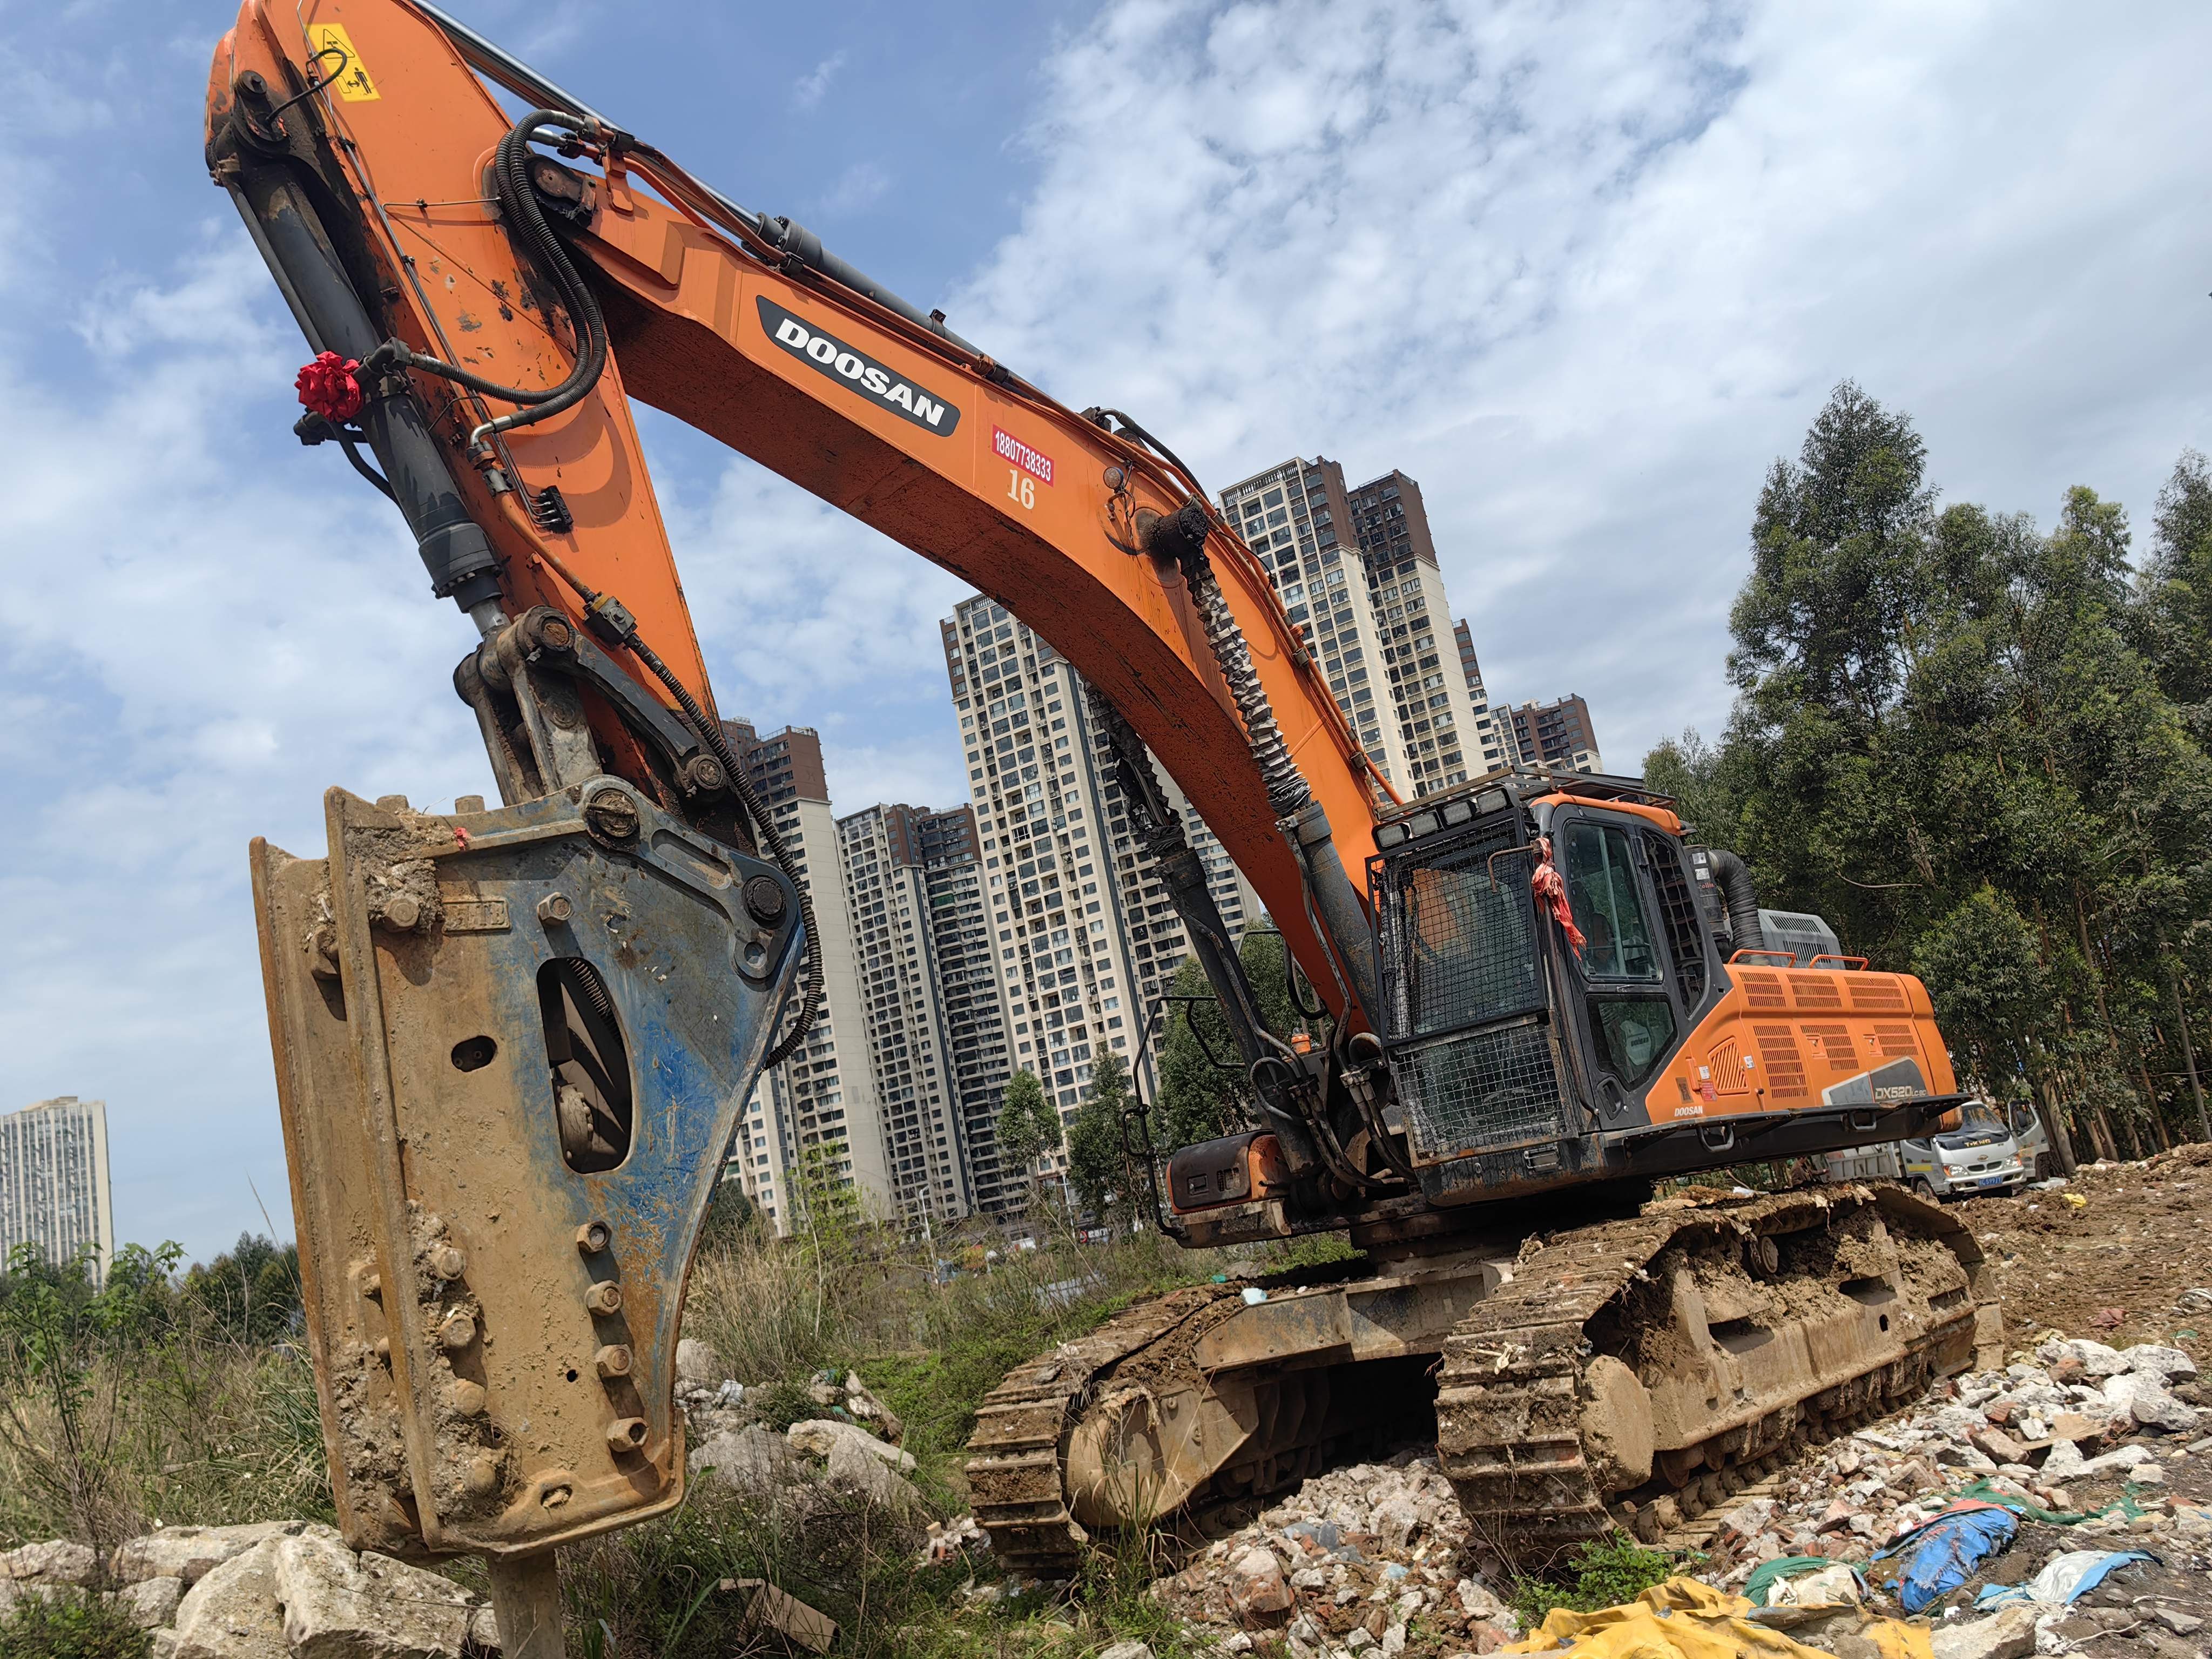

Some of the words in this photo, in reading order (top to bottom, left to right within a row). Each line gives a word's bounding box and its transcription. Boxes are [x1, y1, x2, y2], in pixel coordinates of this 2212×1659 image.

[775, 318, 945, 427] DOOSAN
[995, 430, 1051, 482] 18807738333
[1007, 469, 1035, 509] 16
[1675, 1106, 1703, 1117] DOOSAN
